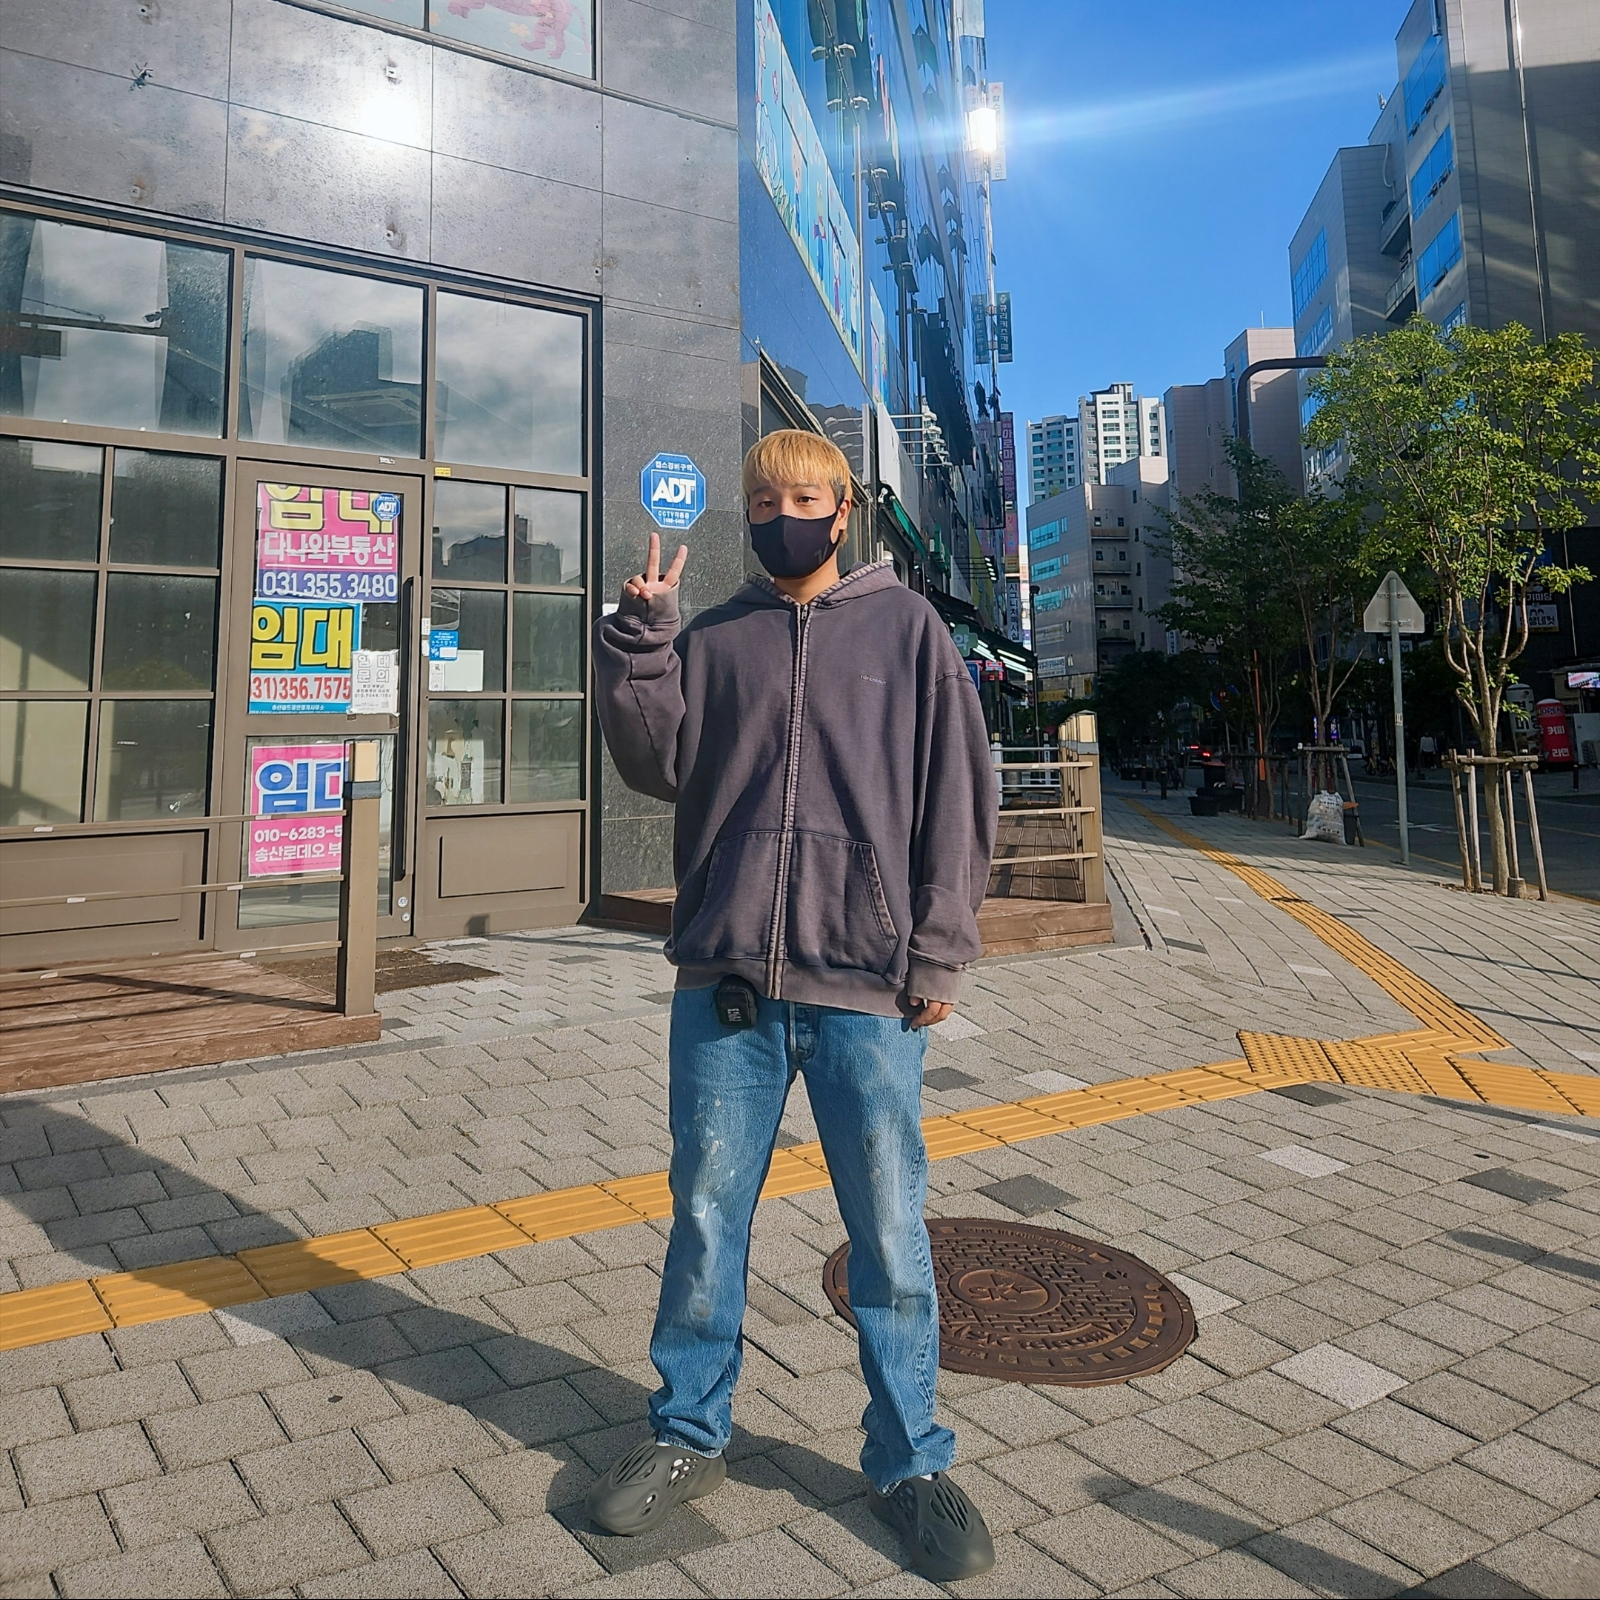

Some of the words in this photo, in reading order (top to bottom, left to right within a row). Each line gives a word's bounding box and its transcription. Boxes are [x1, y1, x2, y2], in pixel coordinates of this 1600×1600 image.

[1002, 429, 1014, 459] 아로마
[652, 477, 696, 505] ADT
[378, 501, 397, 513] ADT
[251, 605, 354, 670] 임대
[953, 634, 970, 650] 약
[1547, 725, 1565, 735] 커피
[255, 843, 325, 863] 송산로데오
